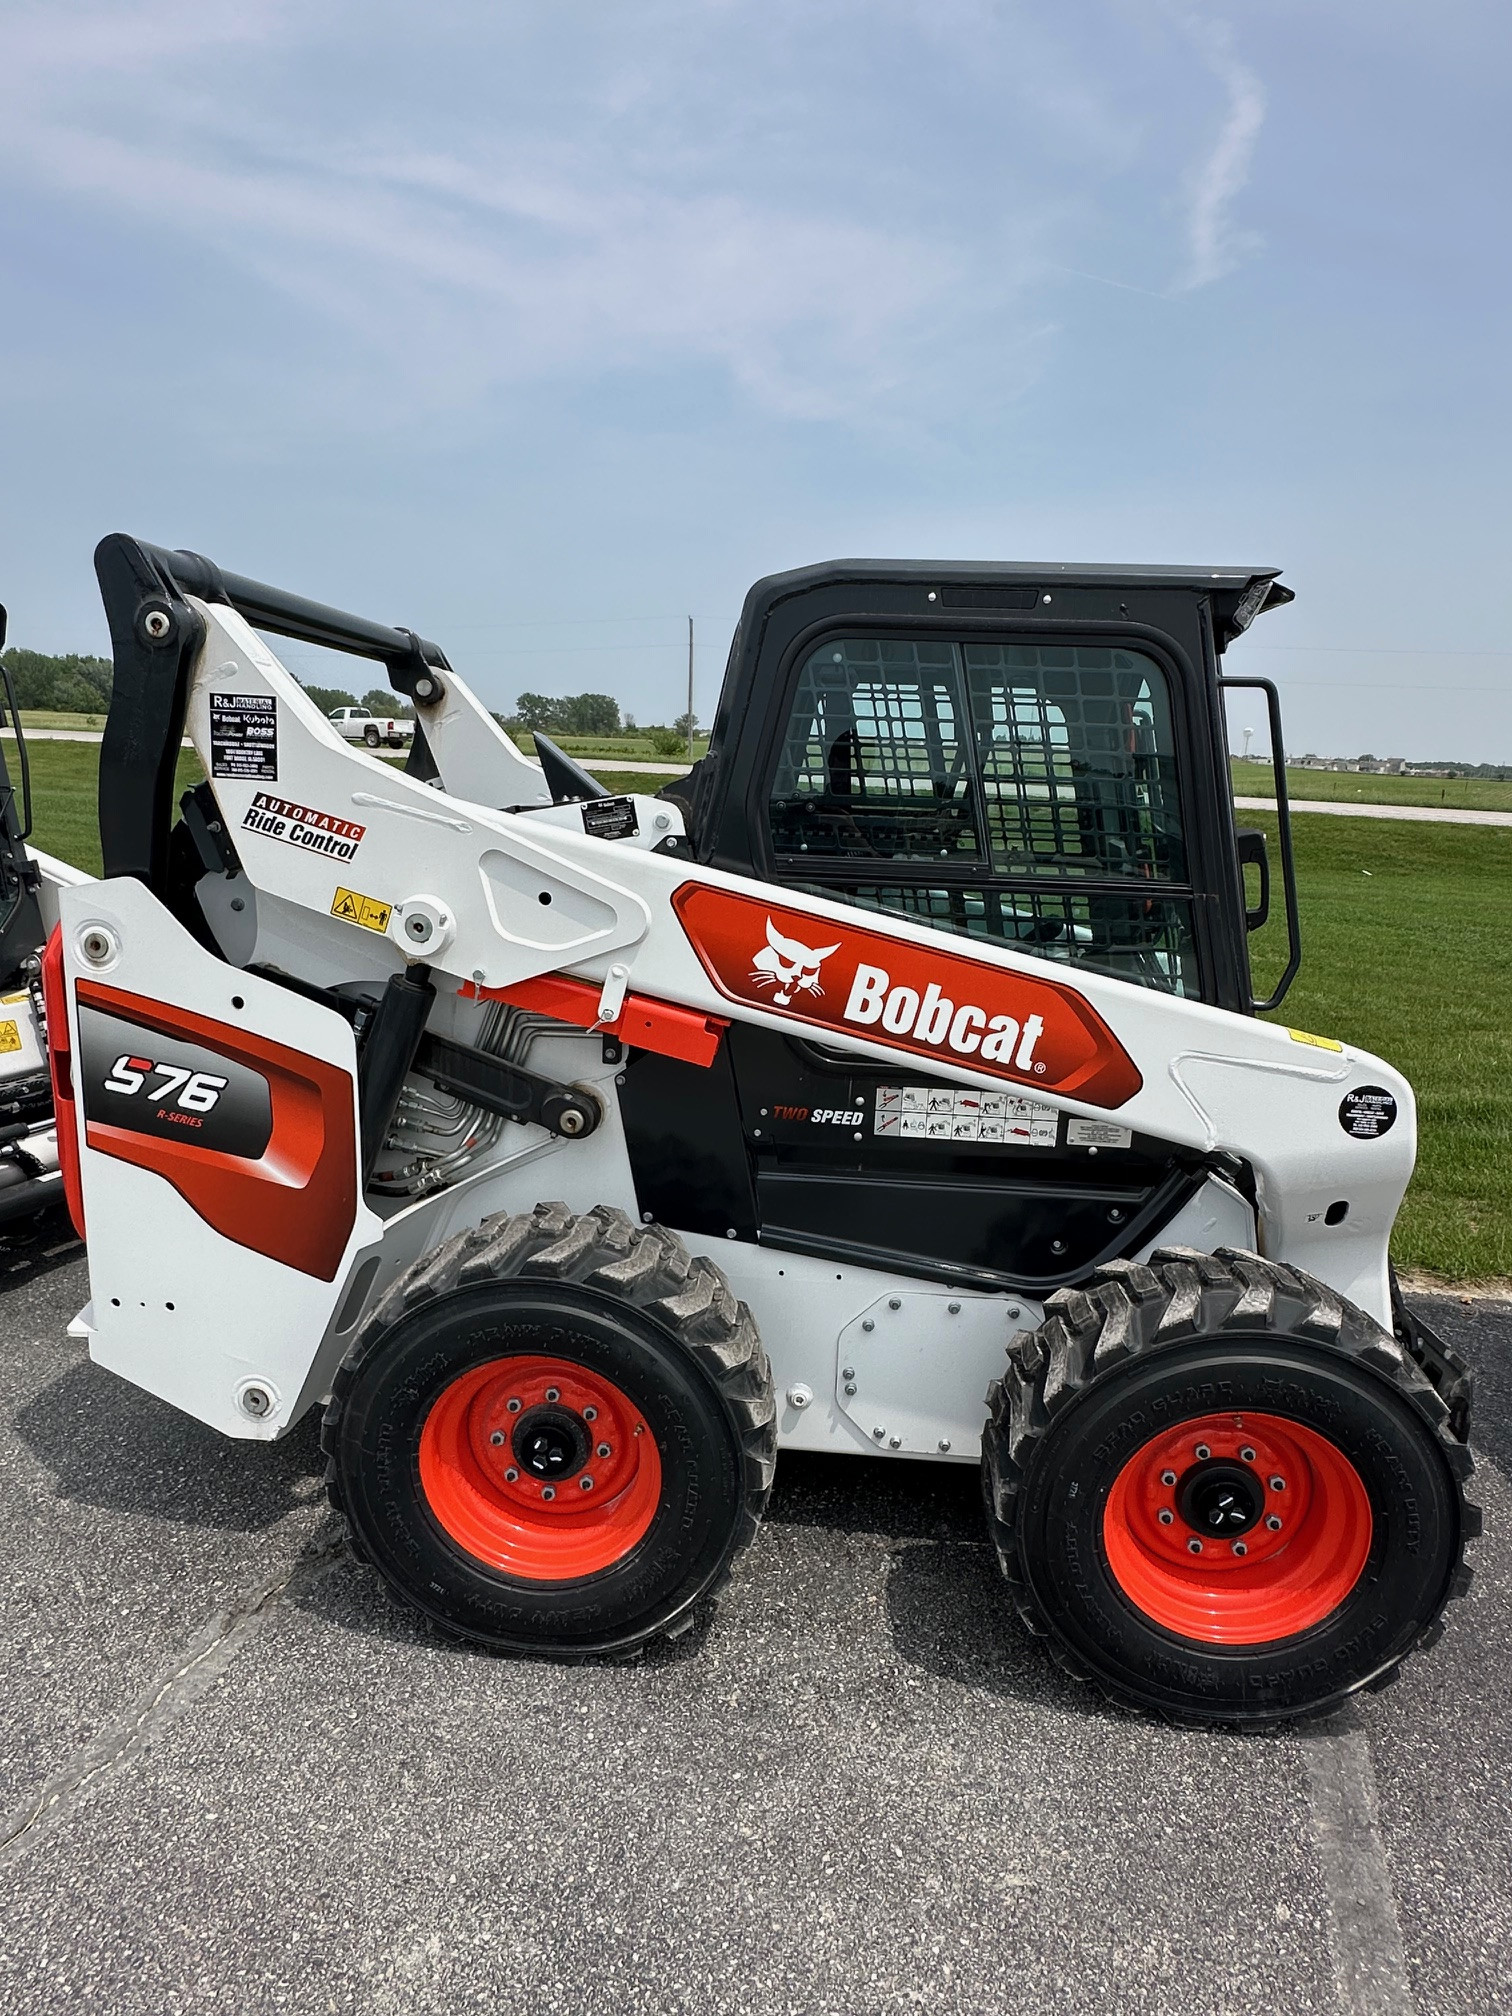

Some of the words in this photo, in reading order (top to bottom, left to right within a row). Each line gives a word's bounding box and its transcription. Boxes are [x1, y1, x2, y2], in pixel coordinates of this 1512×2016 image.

[213, 695, 236, 709] R&J
[243, 714, 275, 725] Kubota
[247, 726, 275, 737] BOSS
[256, 796, 361, 839] AUTOMATIC
[243, 808, 286, 836] Ride
[289, 823, 359, 860] Control
[103, 1054, 229, 1113] S76
[1347, 1093, 1365, 1103] R&J
[156, 1109, 204, 1128] R-SERIES
[774, 1105, 809, 1121] TWO
[811, 1108, 864, 1125] SPEED
